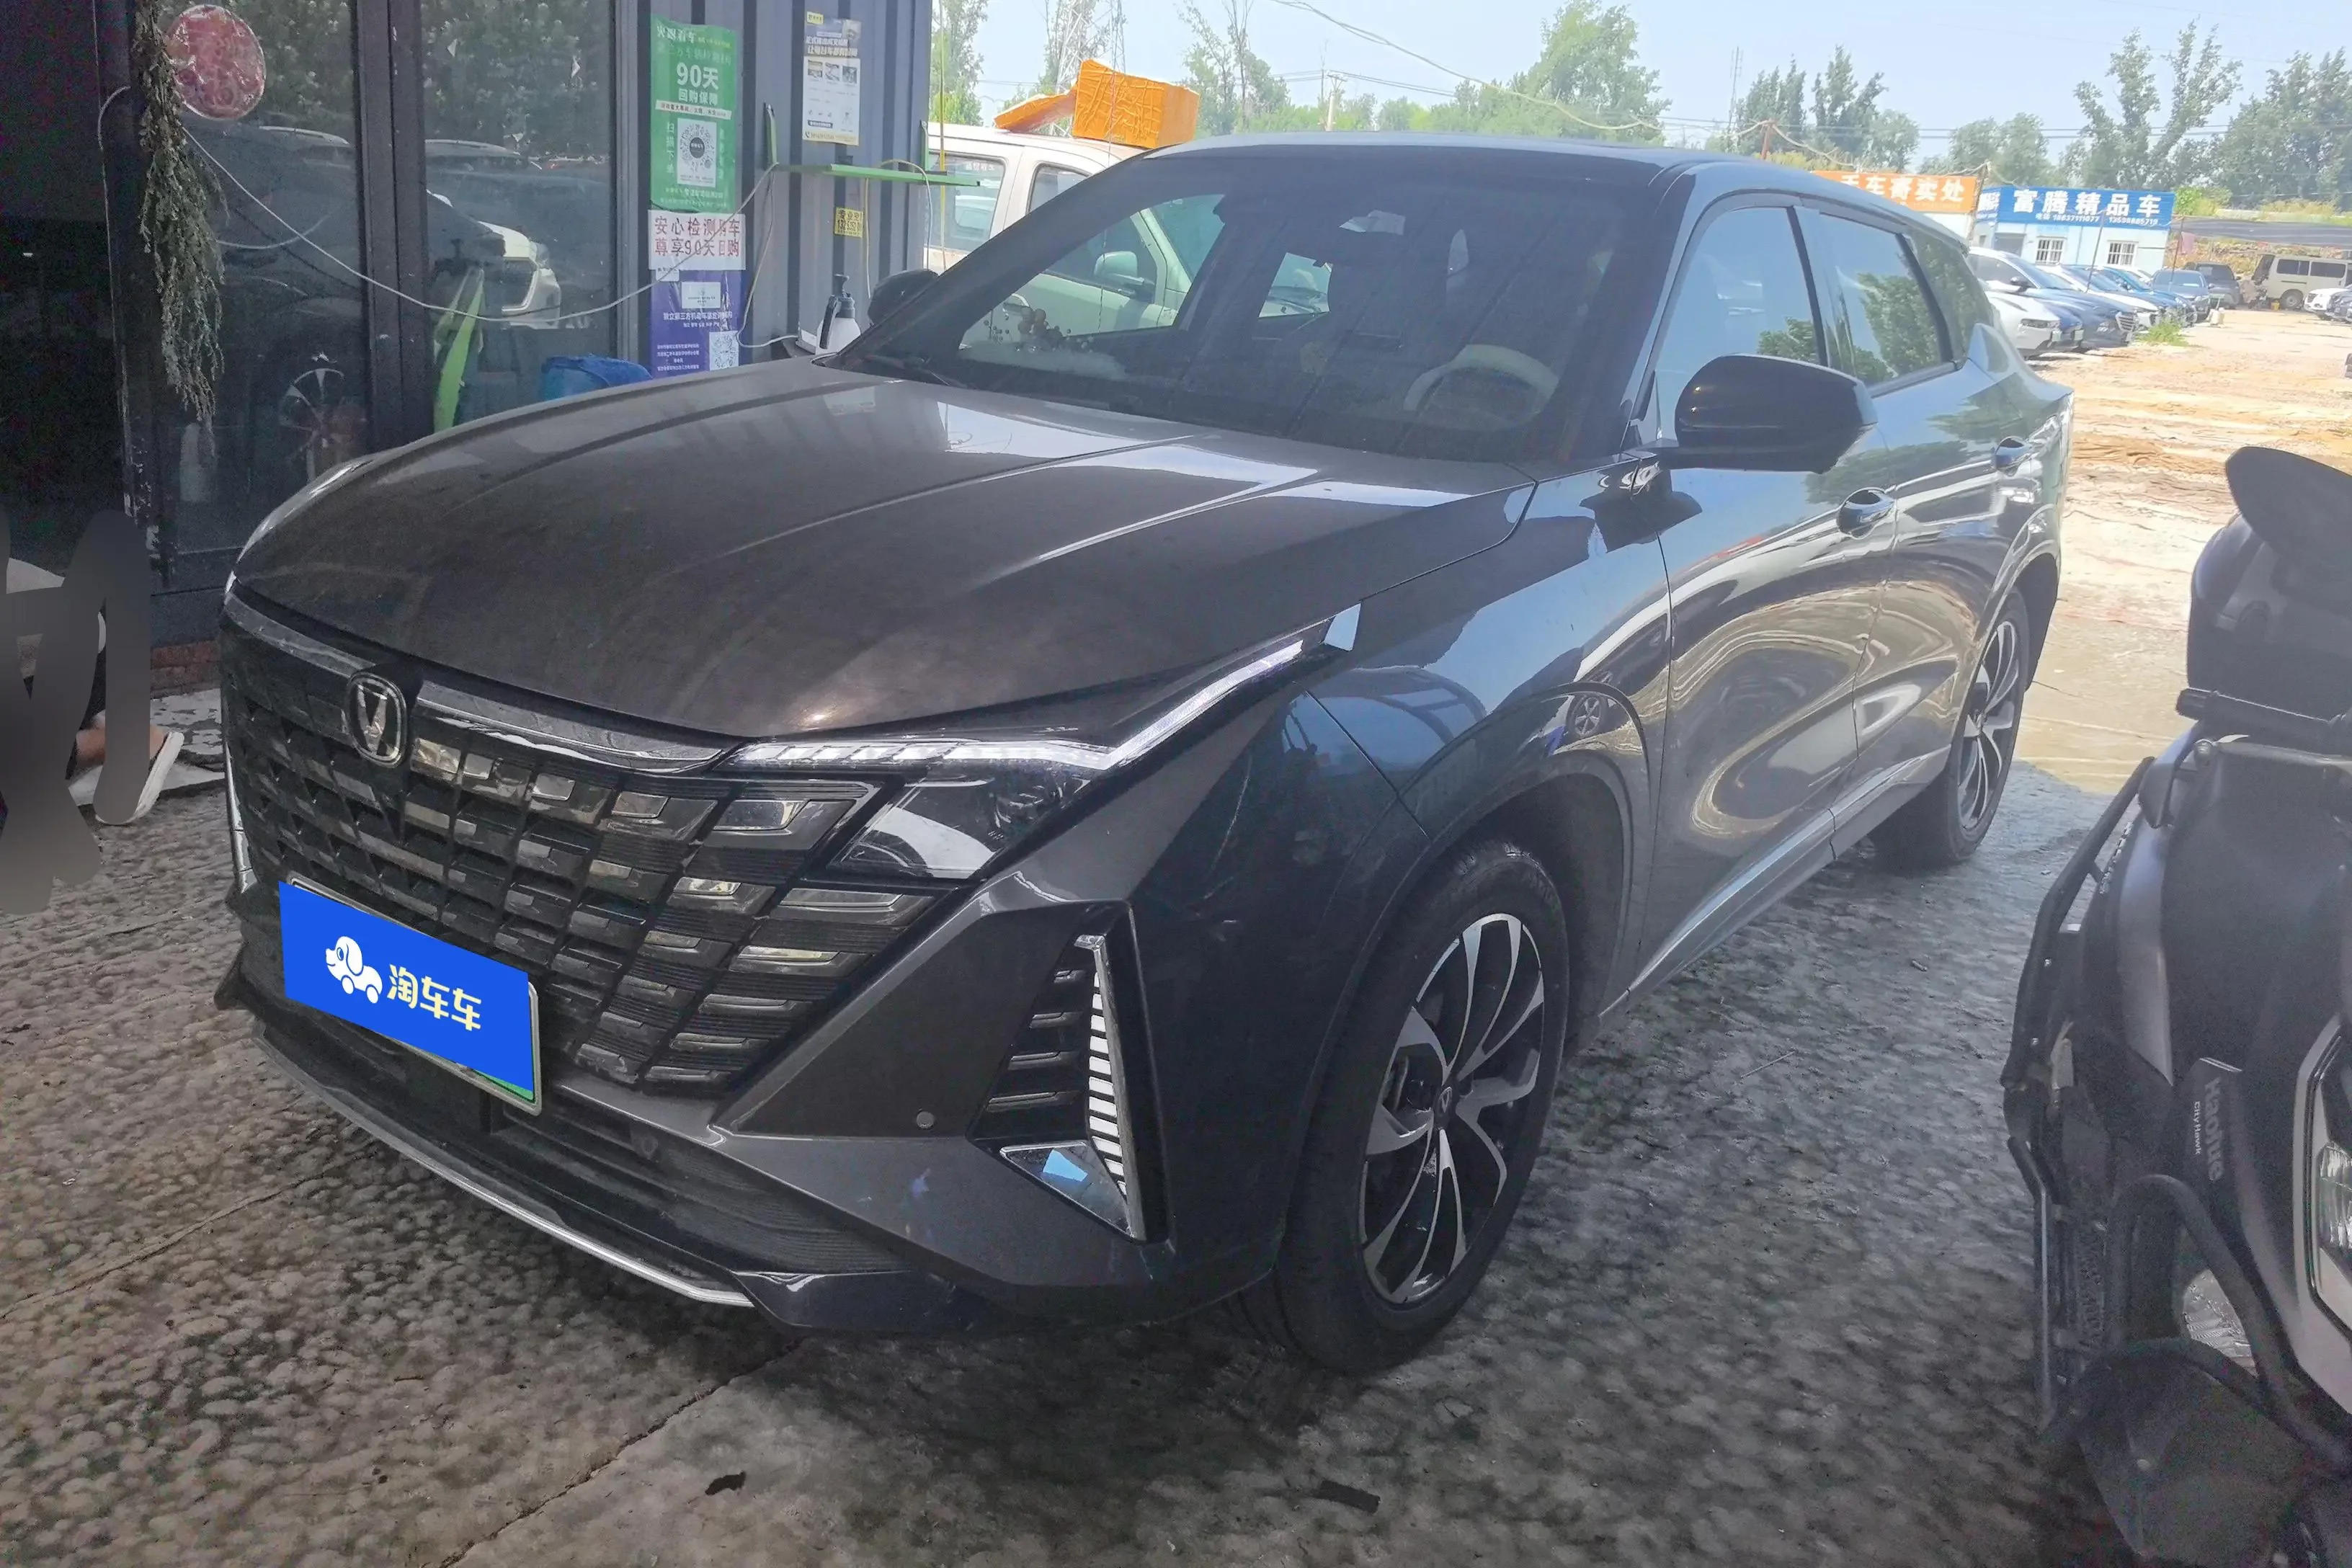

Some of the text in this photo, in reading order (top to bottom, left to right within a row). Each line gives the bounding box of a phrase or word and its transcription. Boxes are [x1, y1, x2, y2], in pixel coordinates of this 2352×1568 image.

[677, 62, 718, 90] 90天
[679, 88, 718, 106] 回购保障
[2013, 190, 2162, 218] 富腾精品车
